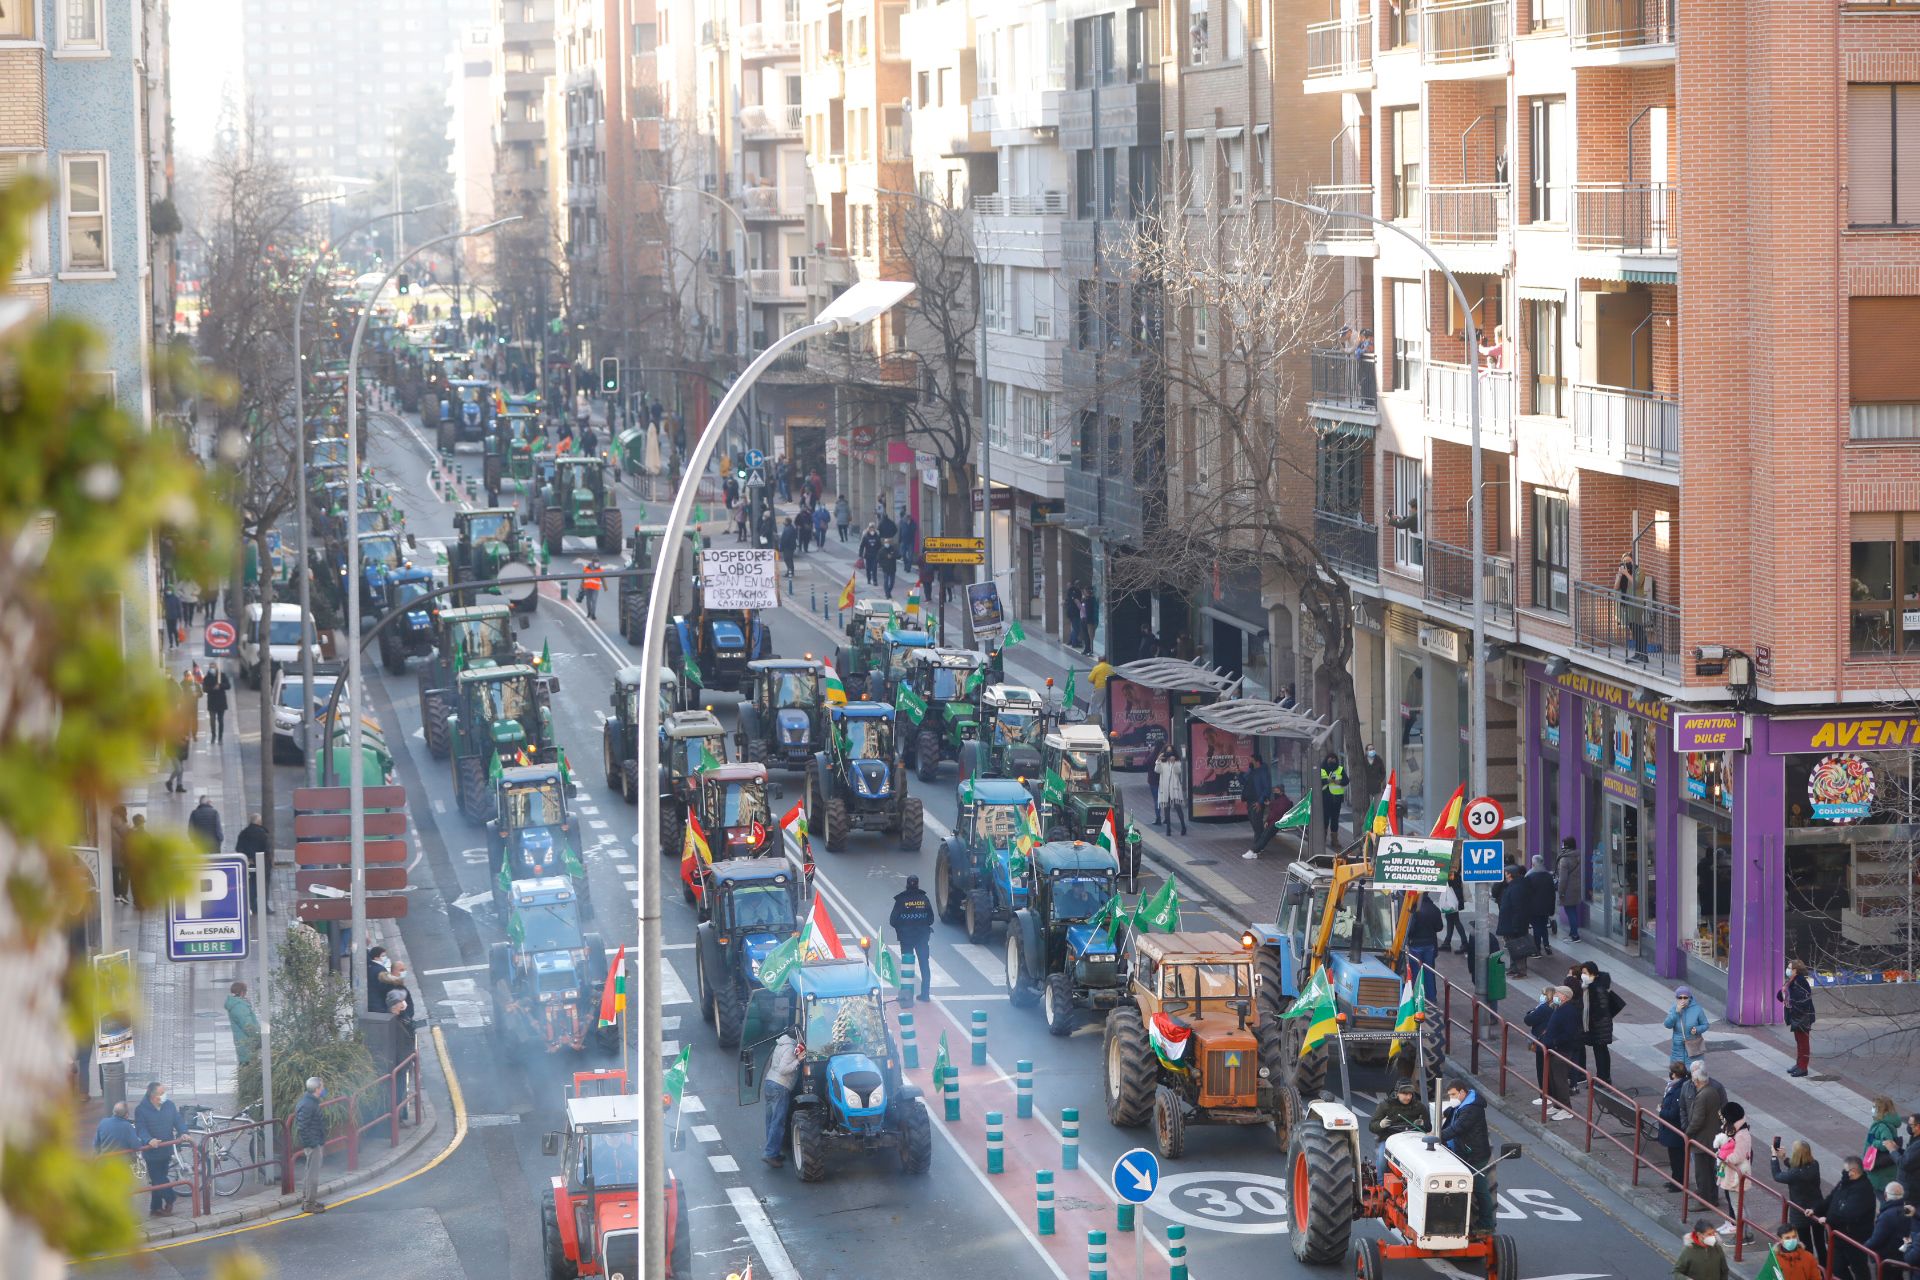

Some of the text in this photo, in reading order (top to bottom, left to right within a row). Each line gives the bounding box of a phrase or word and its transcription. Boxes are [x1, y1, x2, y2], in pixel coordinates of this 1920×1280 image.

[719, 563, 763, 576] LOBOS
[744, 575, 758, 588] EN
[760, 576, 775, 588] LOS
[712, 589, 769, 600] DESPACHOS
[1684, 718, 1737, 729] AVENTURA
[1694, 733, 1727, 744] DULCE
[1471, 810, 1496, 826] 30
[1391, 857, 1403, 865] UN
[1403, 858, 1436, 867] FUTURO
[1469, 848, 1496, 865] VP
[1383, 865, 1441, 874] AGRICULTORES
[1385, 872, 1438, 882] Y GANADEROS
[184, 869, 229, 920] P
[203, 925, 236, 935] ESPAÑA
[191, 942, 227, 952] LIBRE
[1184, 1186, 1287, 1217] 30
